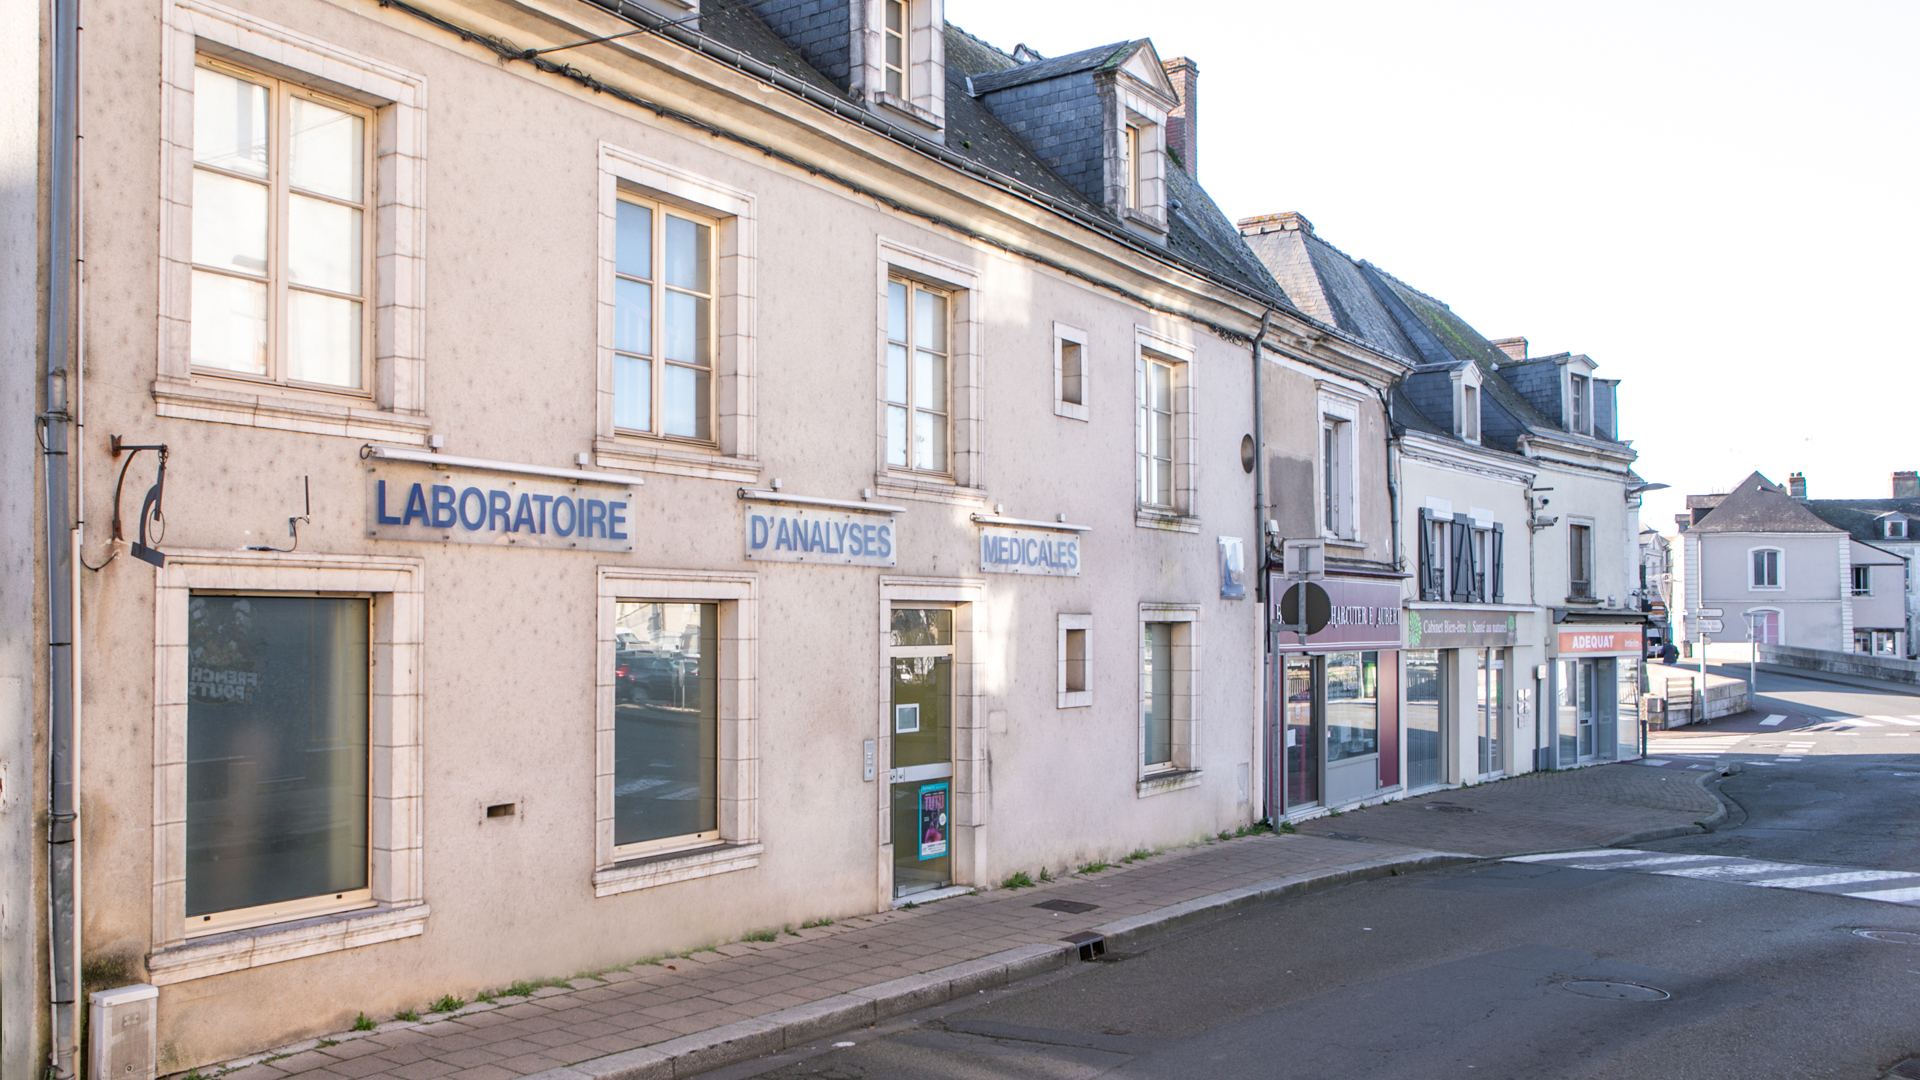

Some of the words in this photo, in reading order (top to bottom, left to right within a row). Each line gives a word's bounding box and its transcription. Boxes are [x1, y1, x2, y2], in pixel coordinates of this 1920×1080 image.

[378, 480, 628, 540] LABORATOIRE
[751, 515, 892, 558] D'ANALYSES
[983, 535, 1078, 569] MEDICALES
[1328, 605, 1374, 628] HARCUTERE
[1424, 620, 1443, 633] Cabinet
[1444, 620, 1466, 633] Bien-être
[1467, 620, 1471, 633] &
[1473, 620, 1485, 633] Santé
[1486, 624, 1492, 633] au
[1492, 621, 1507, 633] naturel
[1572, 635, 1614, 649] ADEQUAT
[924, 795, 944, 811] TUTU
